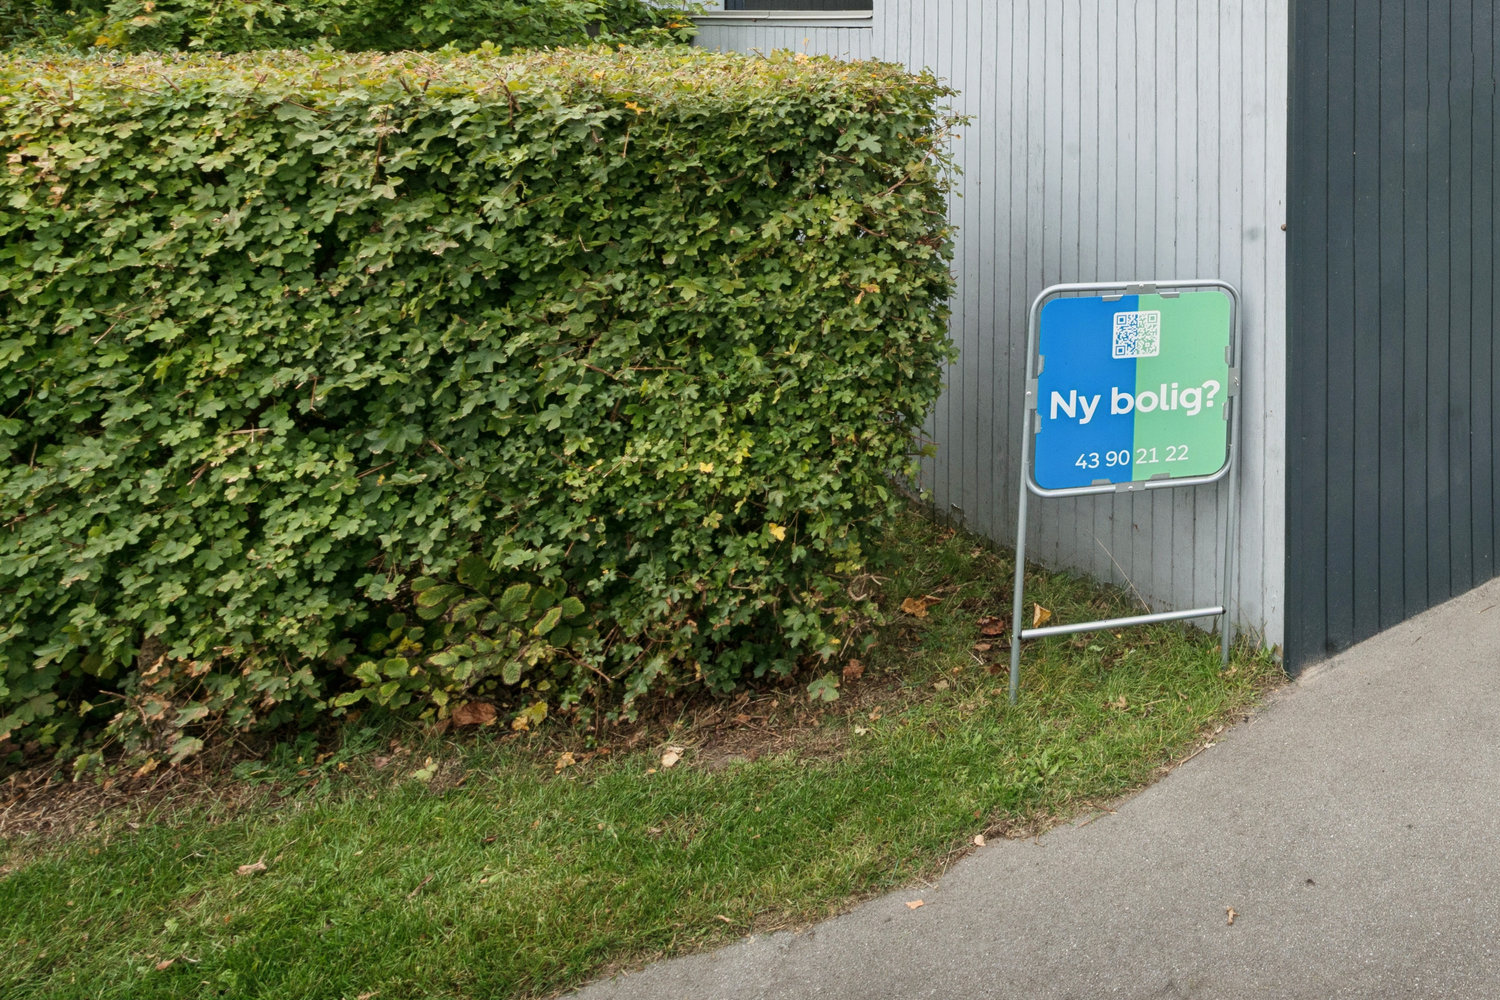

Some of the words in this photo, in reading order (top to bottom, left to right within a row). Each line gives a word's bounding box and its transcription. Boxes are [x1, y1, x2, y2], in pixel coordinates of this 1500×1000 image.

[1050, 390, 1101, 424] Ny
[1110, 380, 1220, 417] bolig?
[1074, 452, 1099, 469] 43
[1105, 449, 1130, 466] 90
[1135, 447, 1159, 464] 21
[1165, 445, 1188, 461] 22
